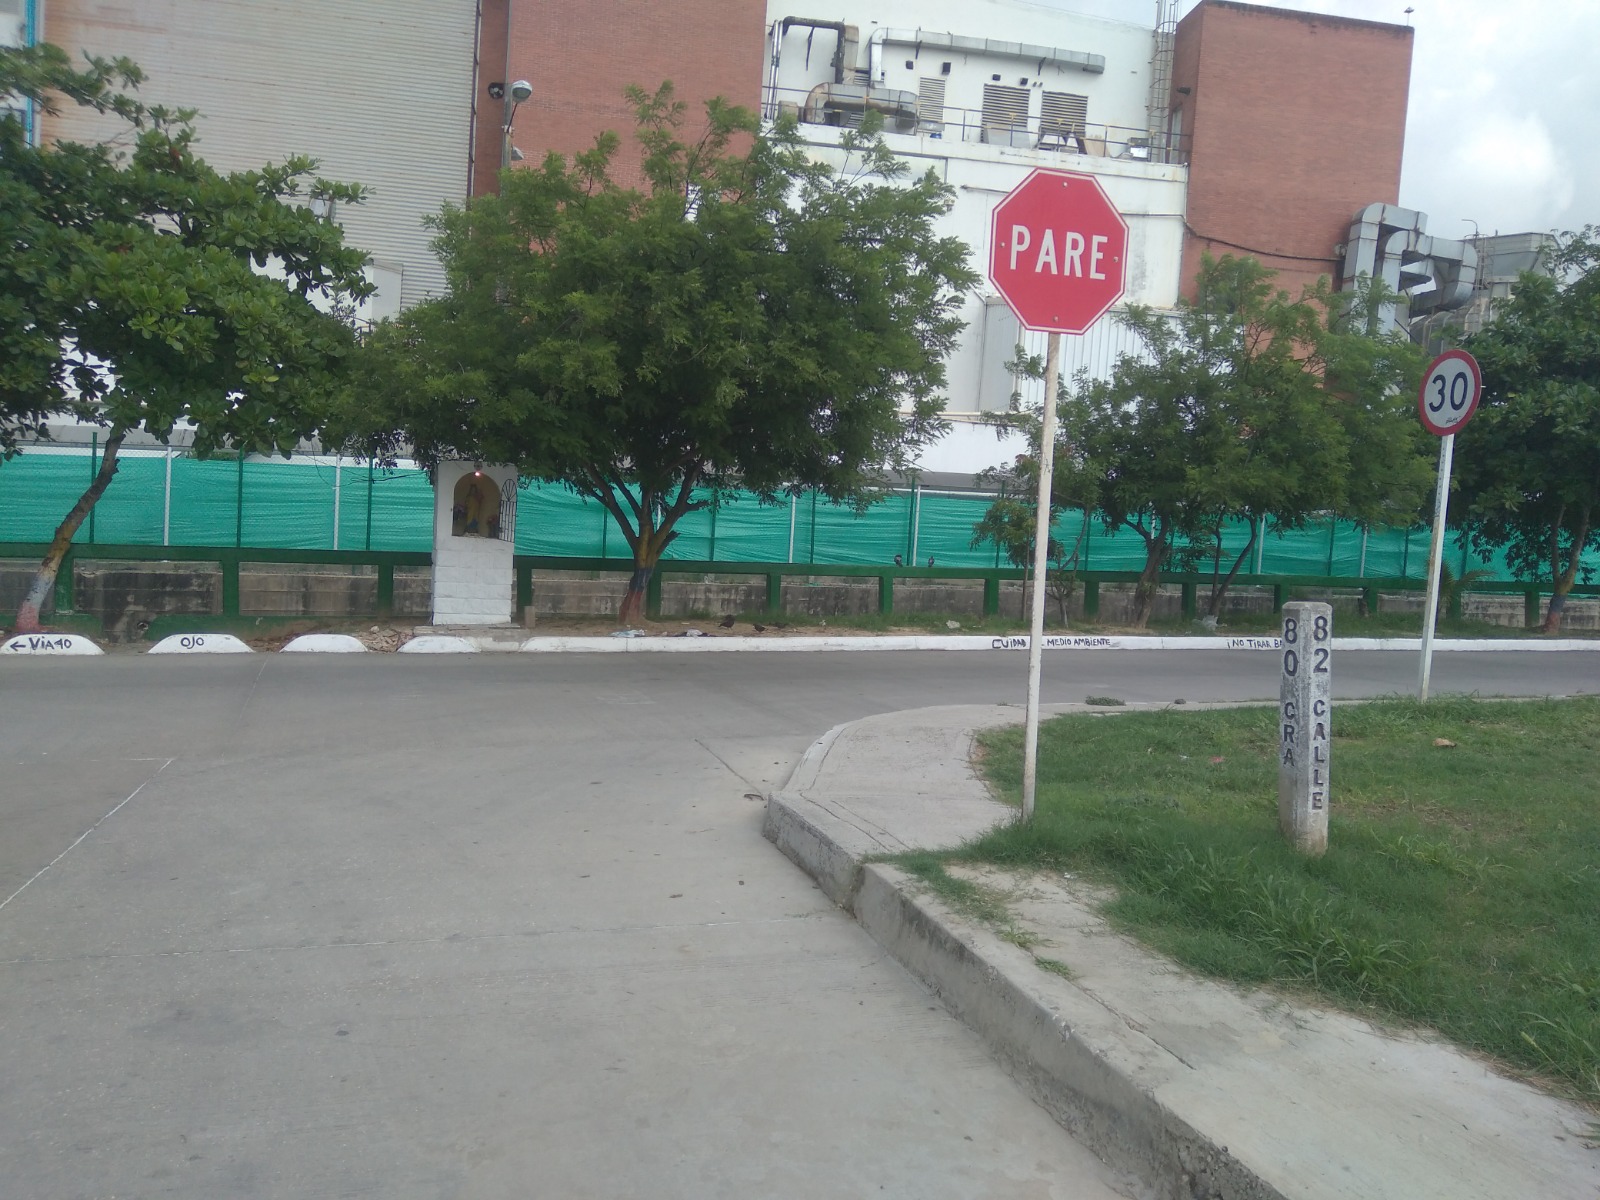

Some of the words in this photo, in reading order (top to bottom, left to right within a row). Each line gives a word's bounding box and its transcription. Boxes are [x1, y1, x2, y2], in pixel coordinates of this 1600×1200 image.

[1010, 224, 1108, 280] PARE
[1428, 371, 1469, 413] 30
[54, 638, 72, 650] 40
[180, 636, 205, 649] OJO
[1283, 702, 1295, 766] CRA
[1312, 700, 1326, 809] CALLE
